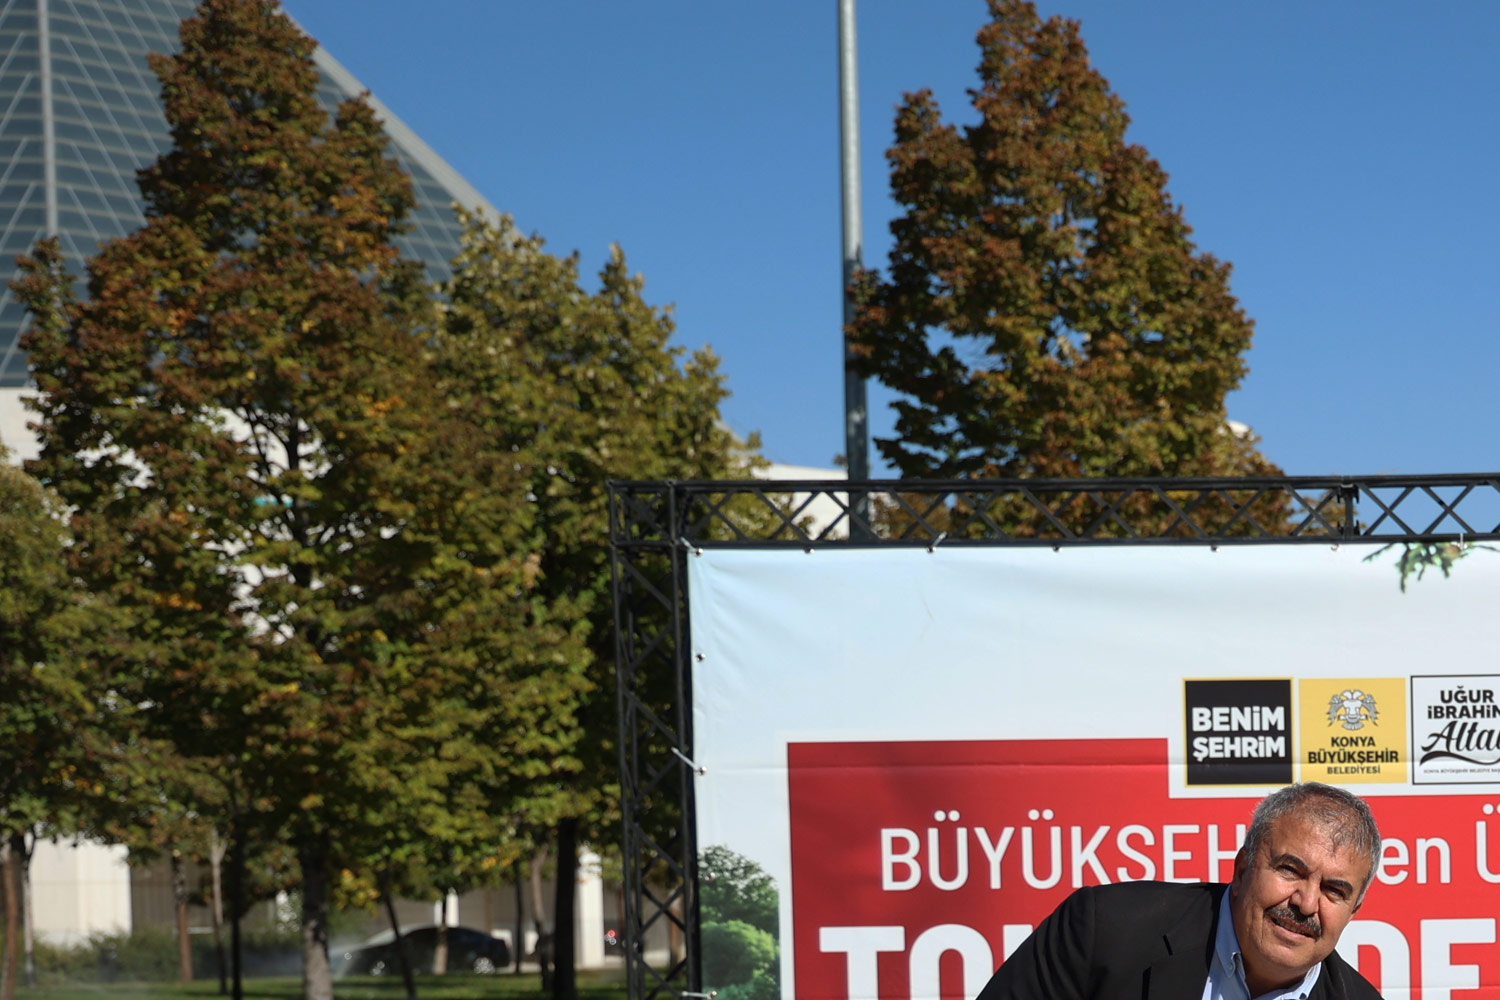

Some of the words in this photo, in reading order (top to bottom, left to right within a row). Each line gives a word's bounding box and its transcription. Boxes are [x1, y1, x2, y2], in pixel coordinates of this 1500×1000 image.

[1440, 686, 1494, 703] UĞUR
[1331, 736, 1376, 747] KONYA
[1308, 748, 1399, 764] BÜYÜKŞEHİR
[1327, 765, 1381, 774] BELEDİYESİ
